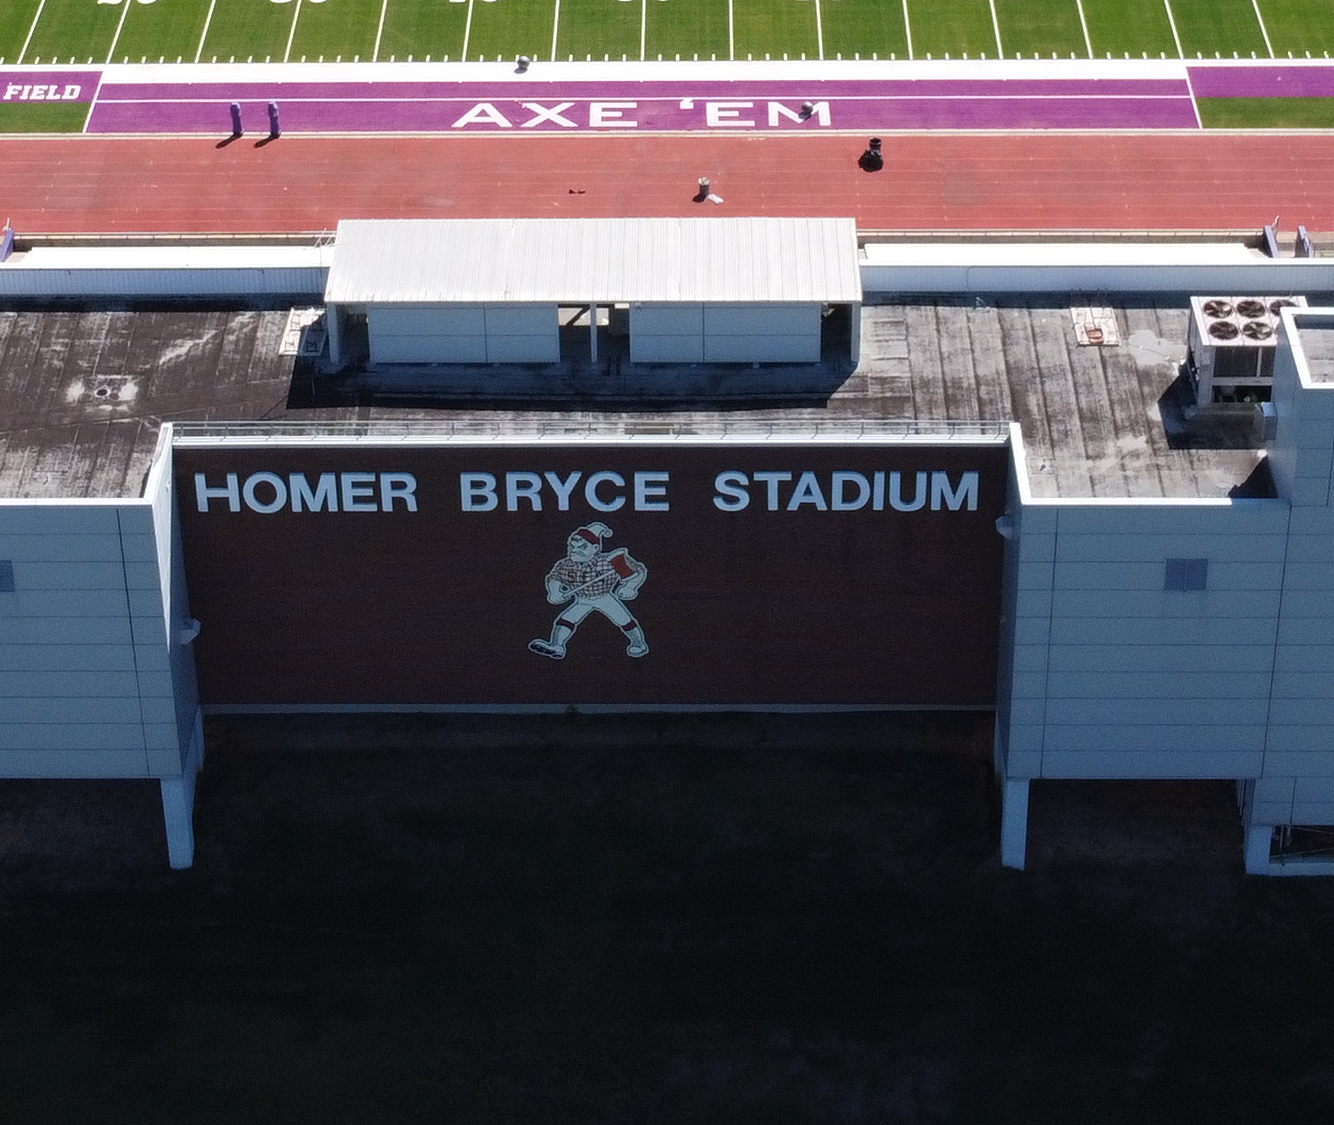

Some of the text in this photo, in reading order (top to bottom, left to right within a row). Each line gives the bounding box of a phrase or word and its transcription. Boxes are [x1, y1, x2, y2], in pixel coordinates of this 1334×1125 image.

[3, 83, 82, 100] FIELD
[452, 102, 638, 128] AXE
[195, 471, 979, 514] HOMER BRYCE STADIUM
